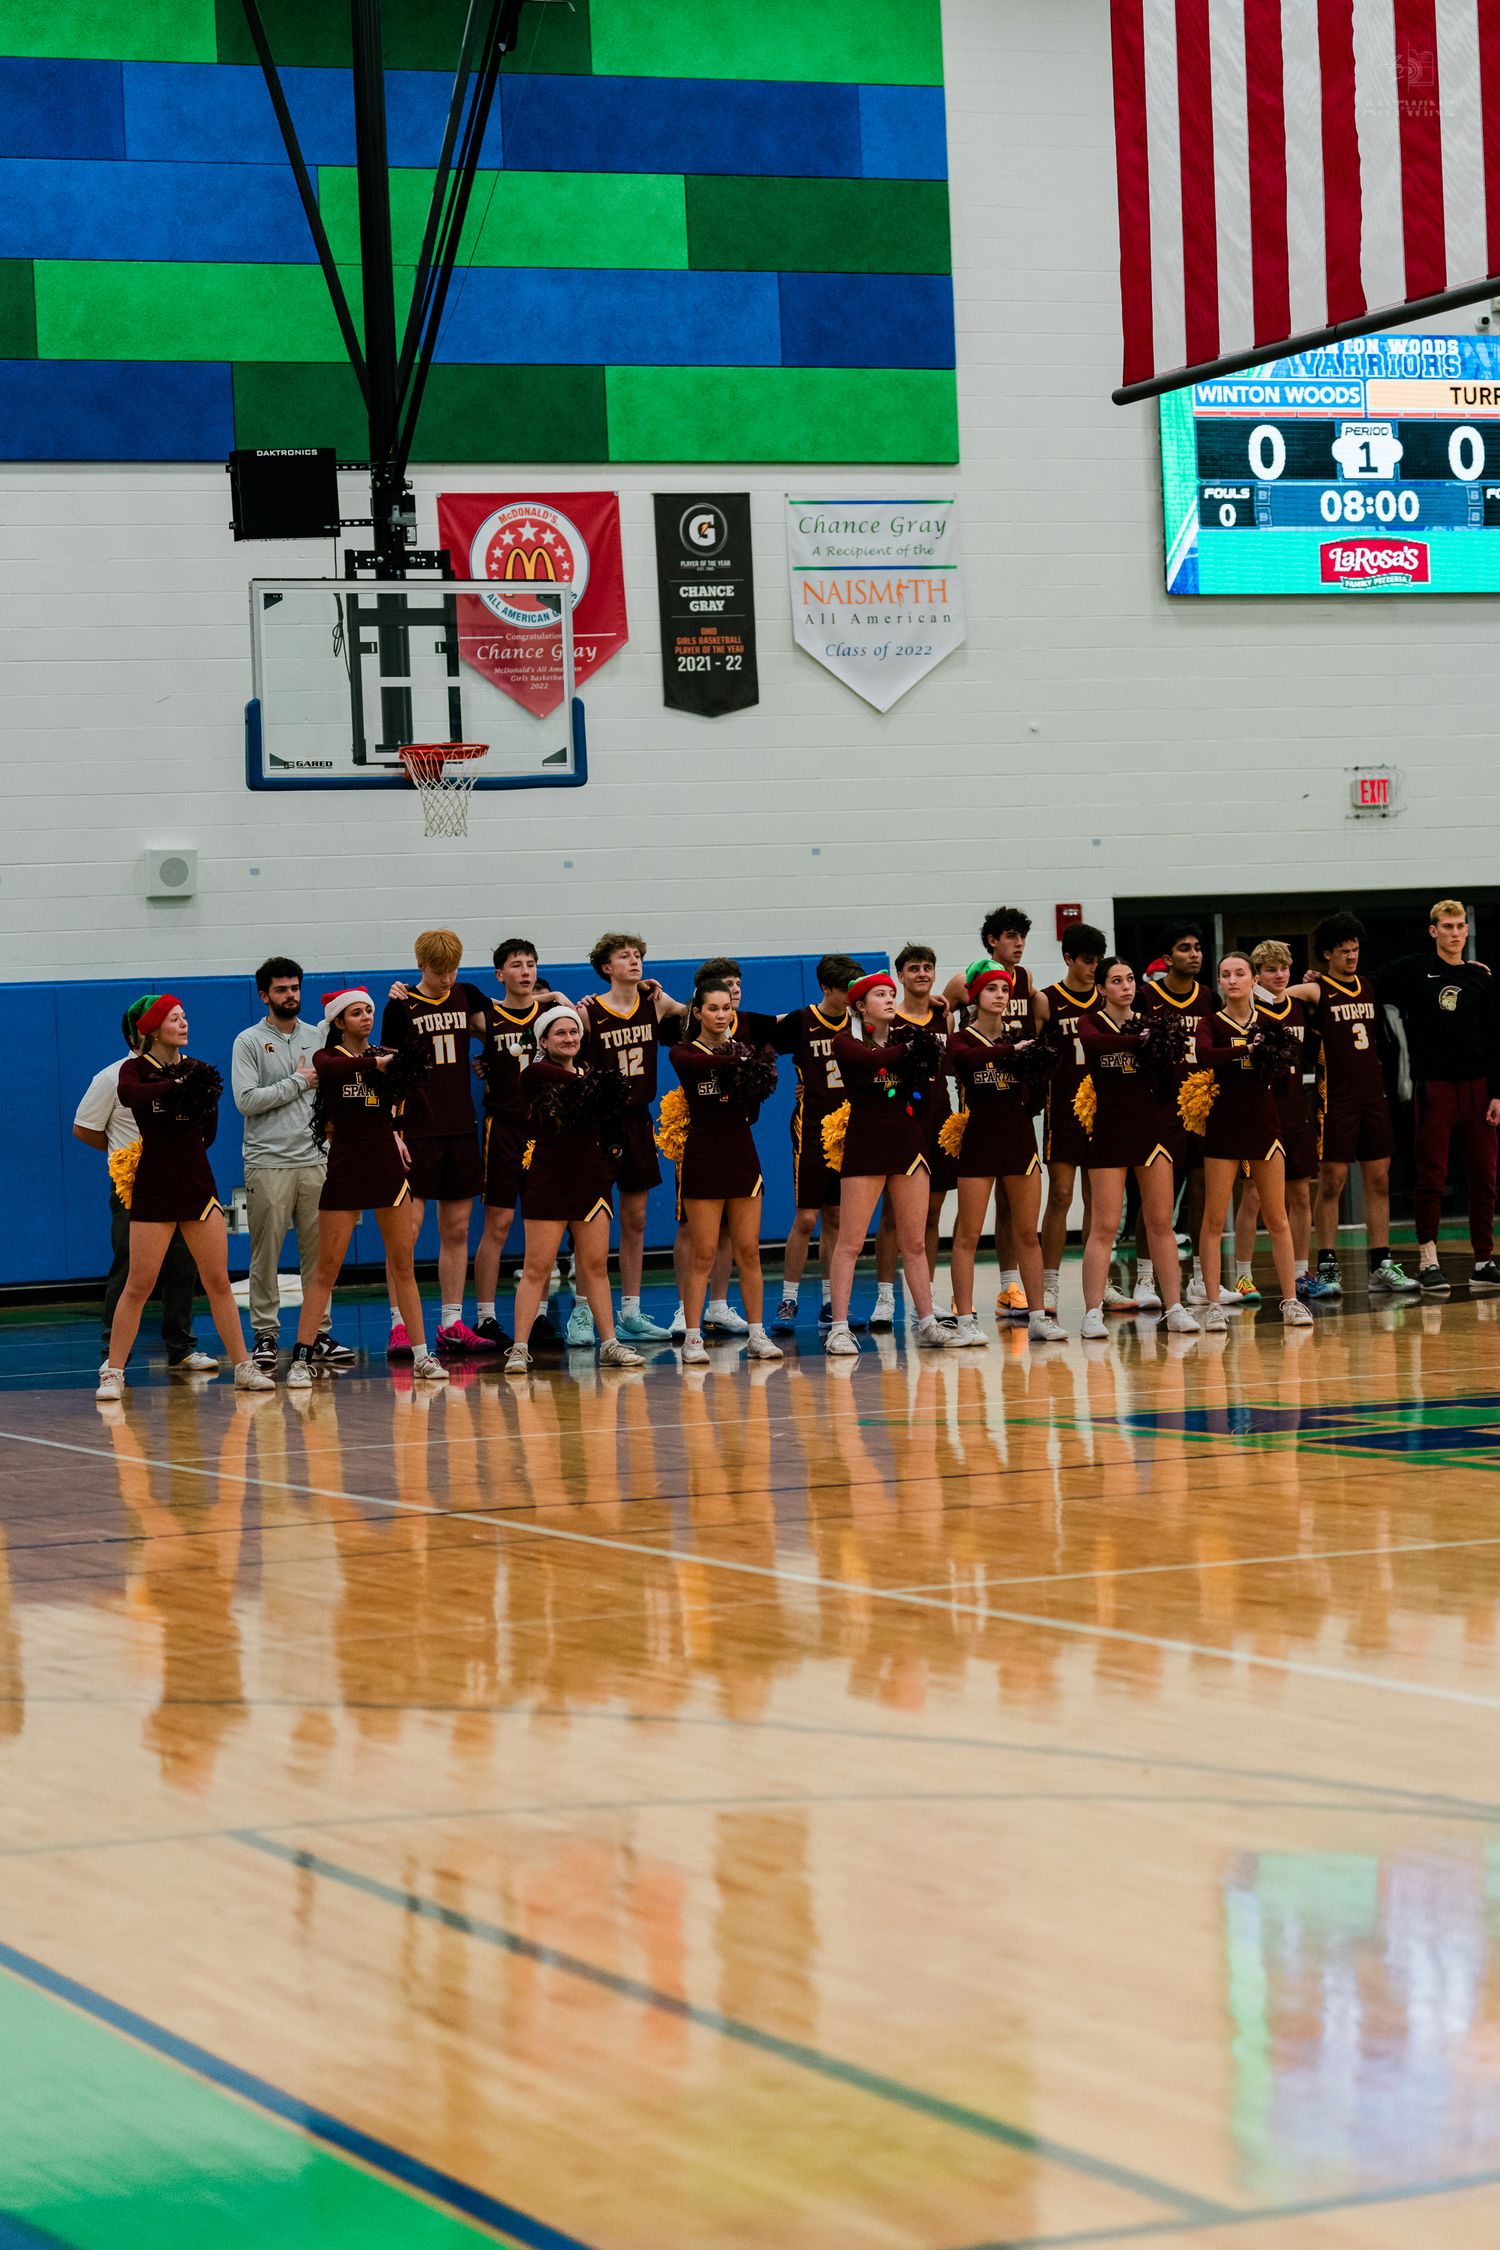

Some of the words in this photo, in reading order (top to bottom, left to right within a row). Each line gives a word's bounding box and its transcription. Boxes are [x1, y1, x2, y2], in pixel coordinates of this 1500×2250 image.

[1309, 339, 1380, 354] NTON
[1387, 338, 1459, 355] WOODS
[1289, 352, 1462, 378] WARRIORS
[1197, 386, 1280, 403] WINTON
[1284, 386, 1361, 403] WOODS
[1345, 426, 1389, 436] PERIOD
[256, 449, 318, 457] DAKTRONICS
[1248, 424, 1286, 481] 0
[1358, 441, 1379, 473] 1
[1448, 425, 1485, 481] 0
[1204, 487, 1250, 499] FOULS
[1218, 503, 1236, 527] 0
[1320, 490, 1420, 522] 08:00
[799, 515, 881, 534] Chance
[890, 516, 946, 539] Gray
[812, 546, 821, 556] A
[827, 546, 892, 560] Recipient
[896, 545, 911, 558] of
[914, 544, 936, 556] the
[679, 586, 735, 597] CHANCE
[486, 593, 501, 610] ALL
[501, 607, 551, 624] AMERICAN
[689, 600, 725, 612] GRAY
[805, 612, 836, 625] All
[850, 612, 952, 625] American
[505, 633, 562, 642] Congratulatio
[676, 636, 697, 645] GIRLS
[698, 635, 742, 645] BASKETBALL
[476, 643, 544, 660] Chance
[551, 643, 597, 662] Gay
[674, 645, 700, 654] PLAYER
[702, 645, 711, 653] OF
[713, 645, 725, 653] THE
[727, 644, 744, 653] YEAR
[825, 642, 867, 657] Class
[873, 642, 891, 661] of
[895, 645, 933, 656] 2022
[677, 655, 711, 672] 2021
[725, 655, 742, 671] 22
[510, 674, 528, 682] Girls
[530, 674, 563, 682] Basketba
[530, 682, 549, 690] 2022
[1360, 779, 1389, 804] EXIT
[1330, 1002, 1375, 1022] TURPIN
[413, 1011, 467, 1034] TURPIN
[601, 1024, 652, 1049] TURPIN
[1352, 1022, 1369, 1050] 3
[432, 1034, 456, 1064] 11
[618, 1047, 645, 1077] 12
